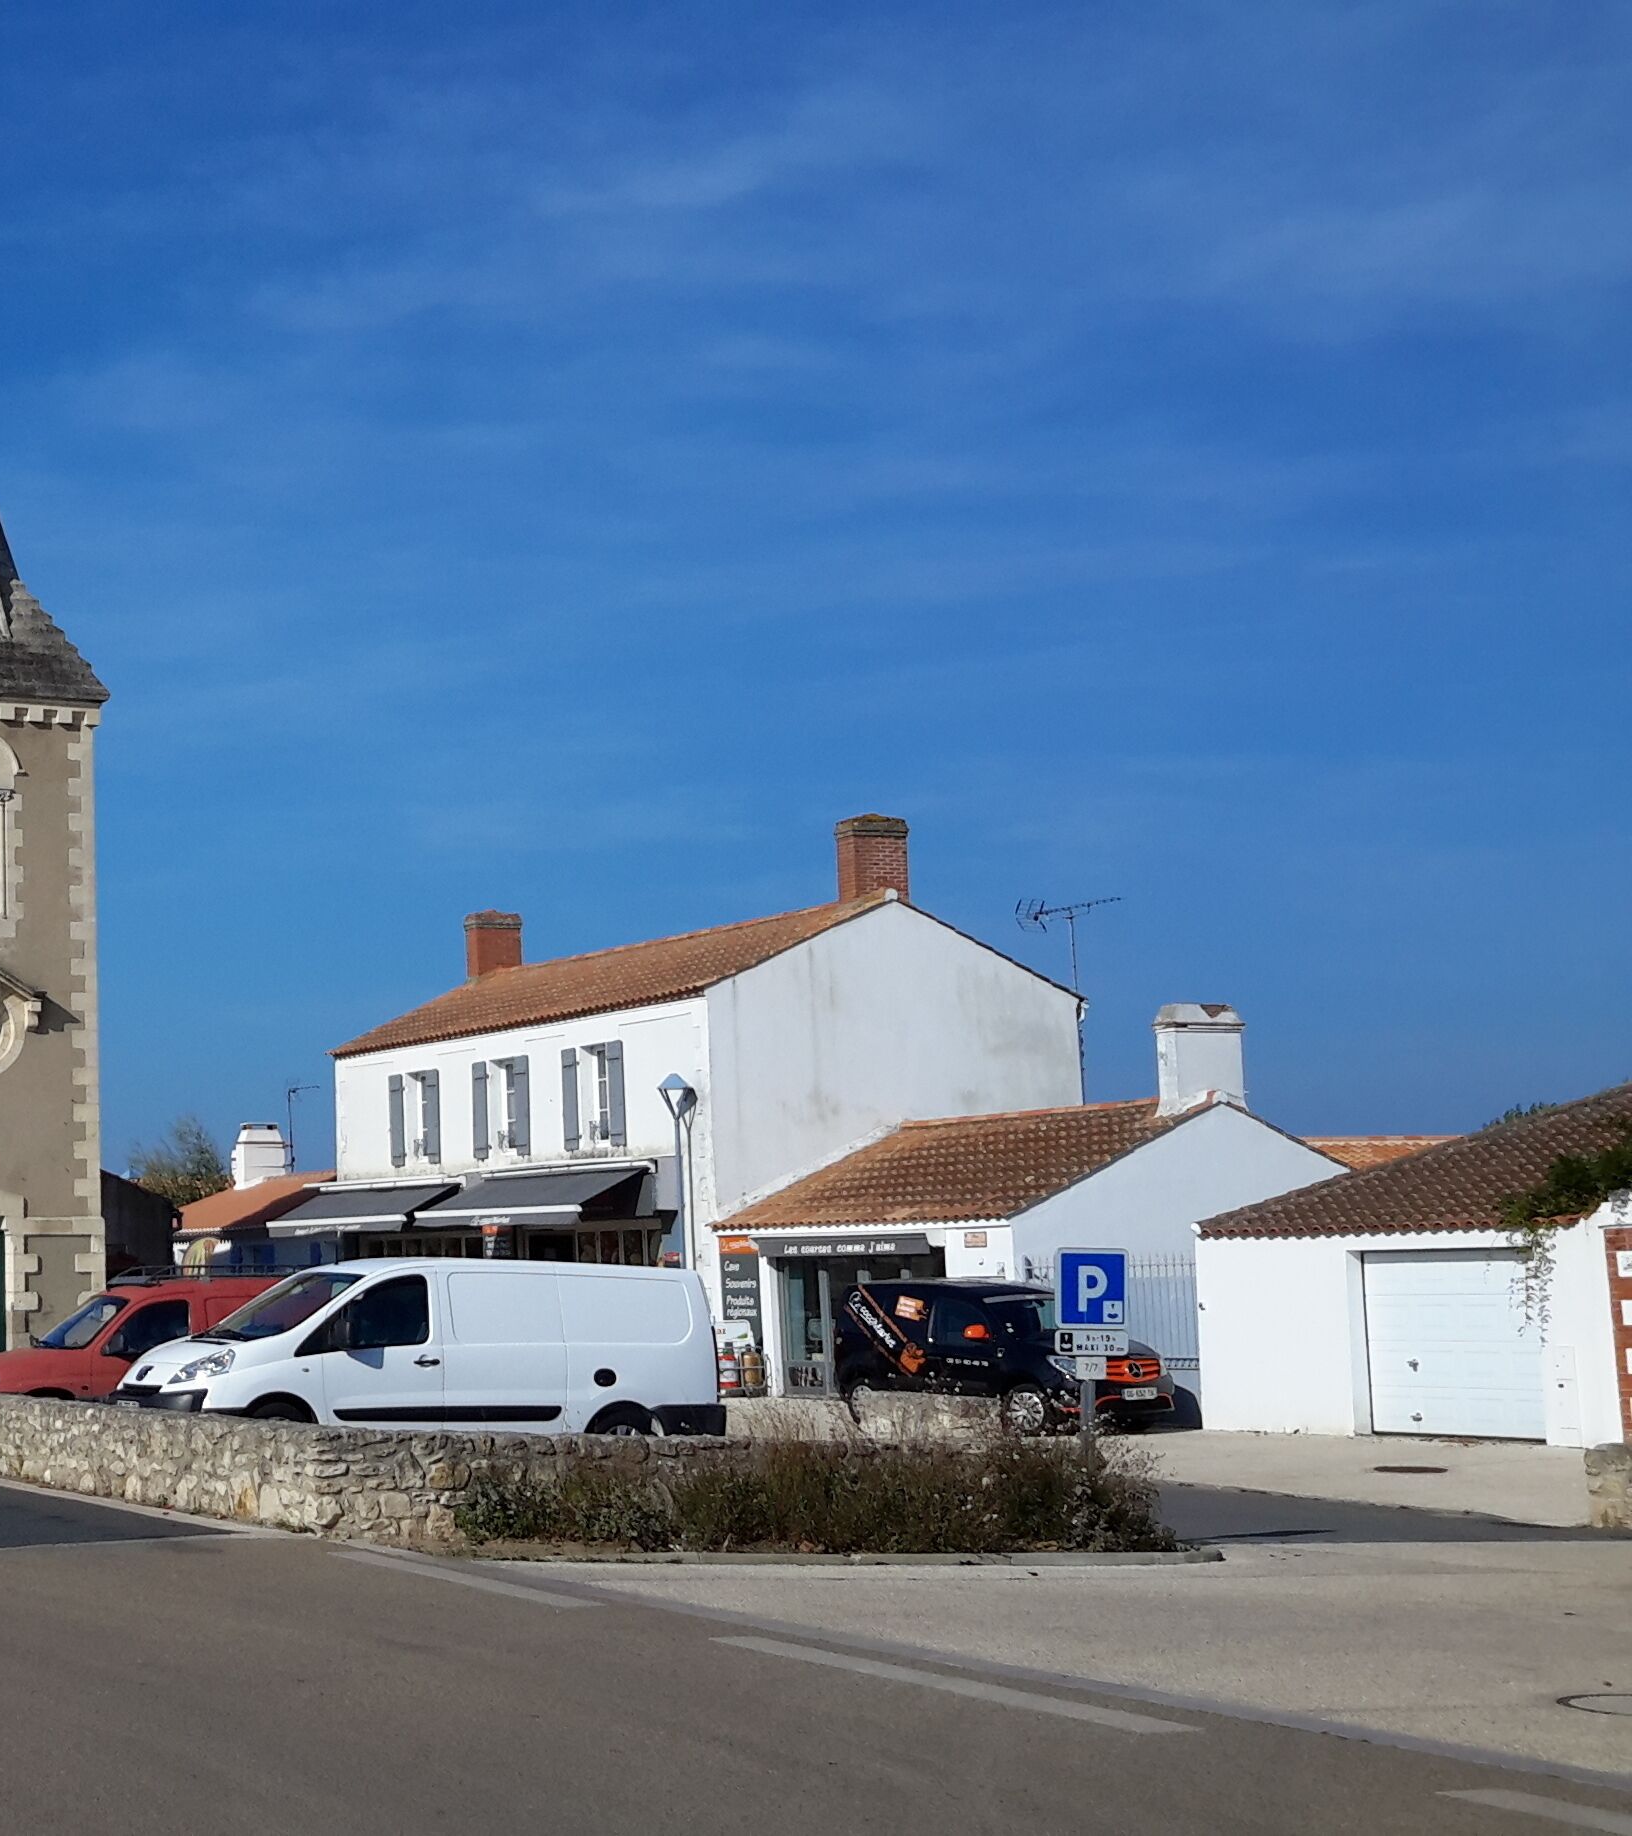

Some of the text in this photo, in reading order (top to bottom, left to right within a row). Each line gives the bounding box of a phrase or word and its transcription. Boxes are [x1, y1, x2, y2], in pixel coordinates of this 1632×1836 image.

[783, 1244, 798, 1255] Les
[800, 1244, 832, 1254] courses
[836, 1243, 865, 1253] comme
[1077, 1264, 1108, 1312] P
[725, 1294, 755, 1306] Produits
[1076, 1344, 1099, 1352] MAXI
[1103, 1344, 1115, 1352] 30
[1084, 1362, 1099, 1372] 7/7
